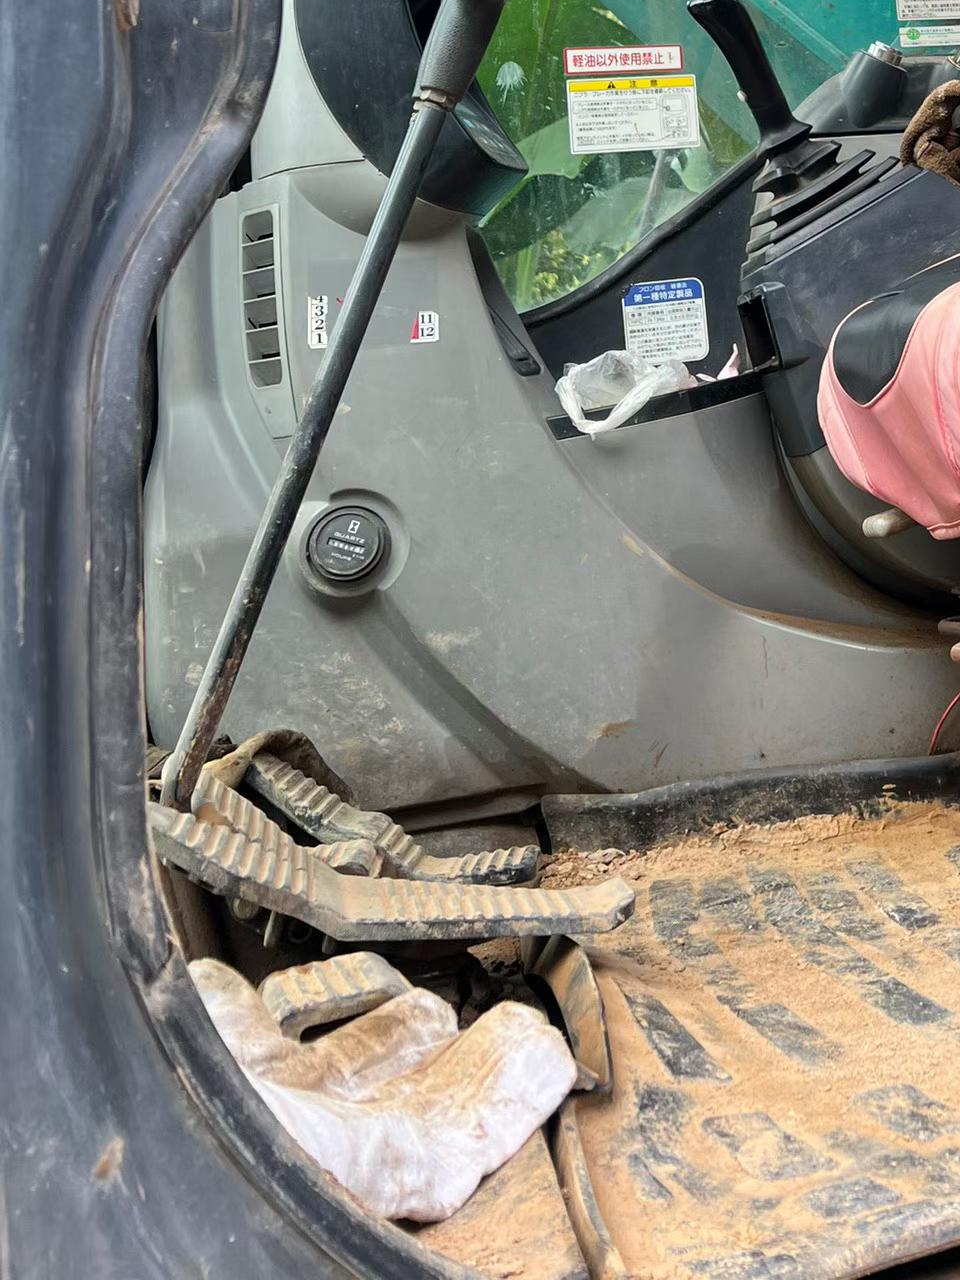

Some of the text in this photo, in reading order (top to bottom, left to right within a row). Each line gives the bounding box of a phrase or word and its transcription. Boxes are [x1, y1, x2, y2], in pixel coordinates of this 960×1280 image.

[633, 289, 694, 303] 第一種特定製品
[315, 305, 324, 317] 3
[315, 319, 325, 330] 2
[420, 314, 433, 324] 11
[420, 327, 434, 337] 12
[316, 333, 323, 344] 1
[333, 531, 366, 543] QUARTZ
